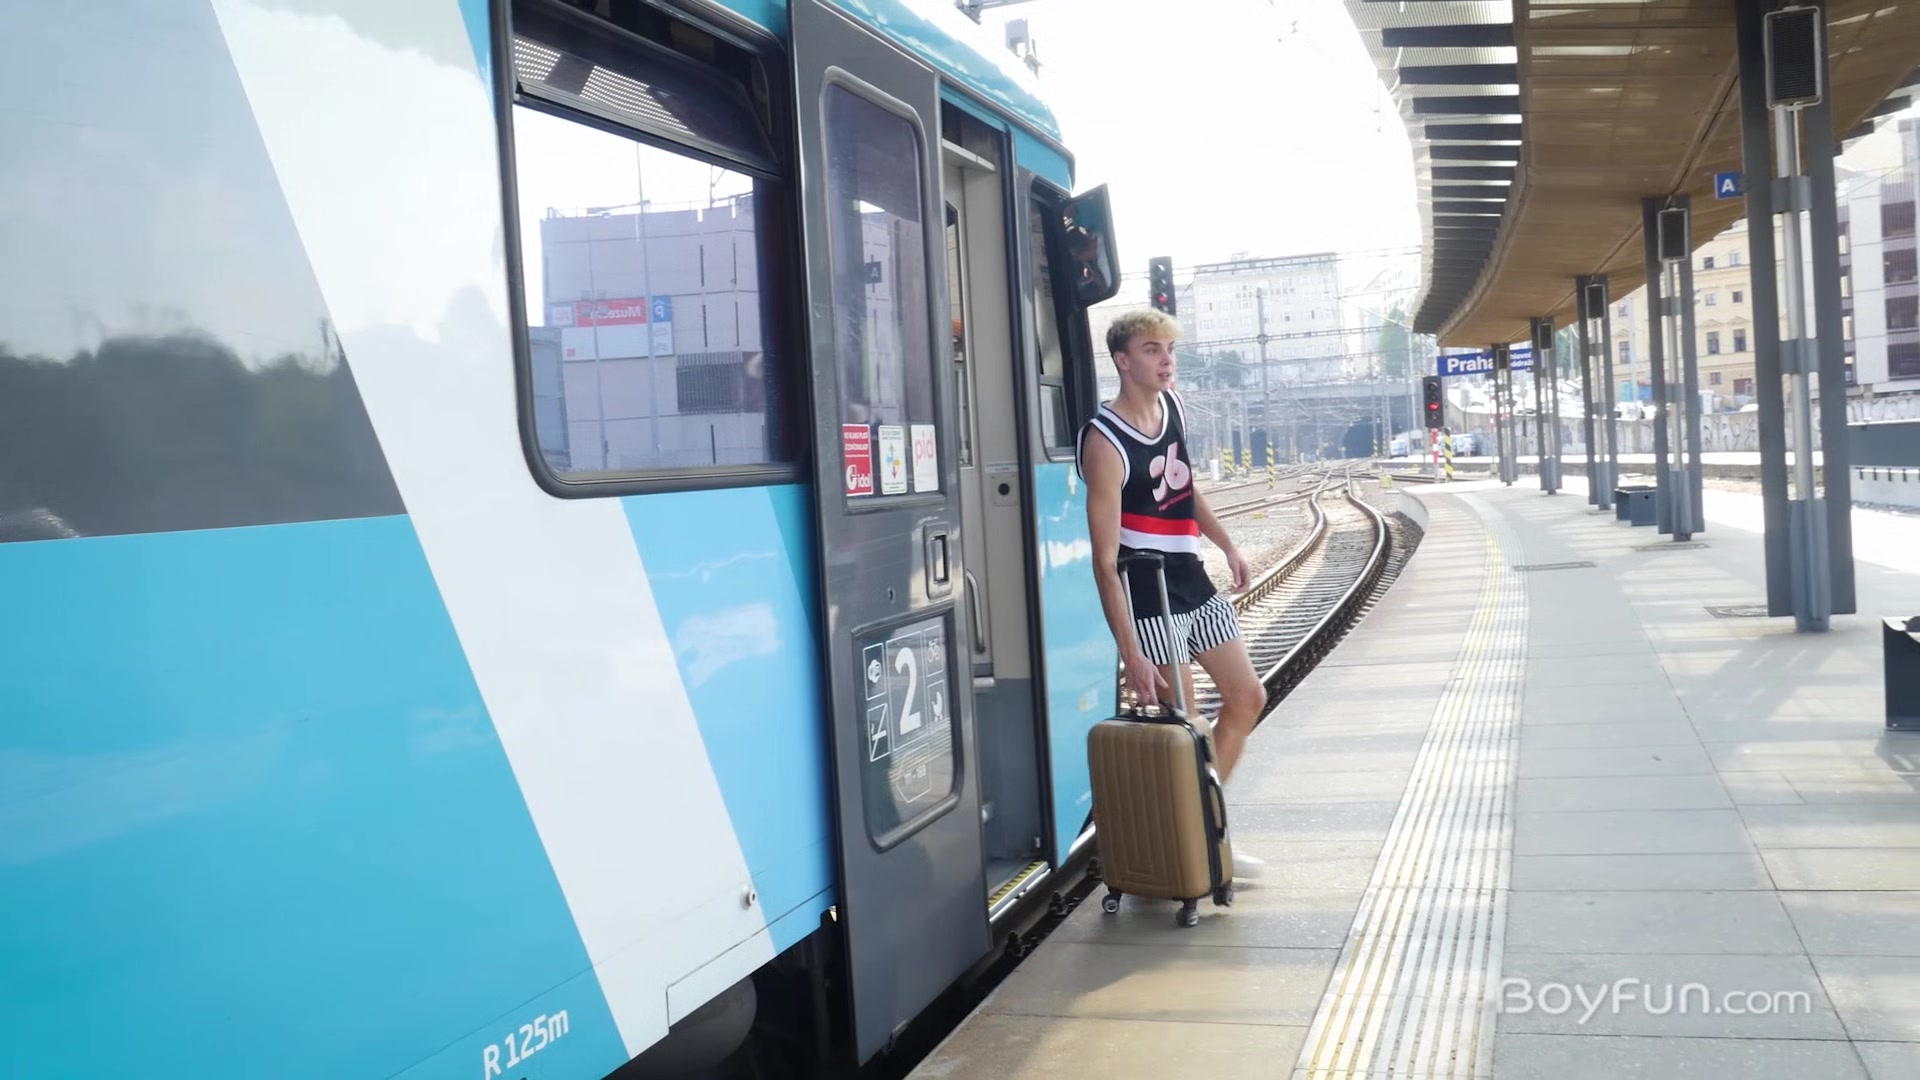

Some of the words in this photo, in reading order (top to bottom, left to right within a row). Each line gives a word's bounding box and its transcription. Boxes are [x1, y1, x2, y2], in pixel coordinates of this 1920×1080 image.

[1721, 178, 1735, 193] A
[1447, 355, 1493, 373] Praha
[915, 431, 933, 467] pid
[1149, 441, 1191, 502] 36
[894, 646, 922, 736] 2
[483, 1043, 502, 1080] R
[504, 1009, 569, 1069] 125m
